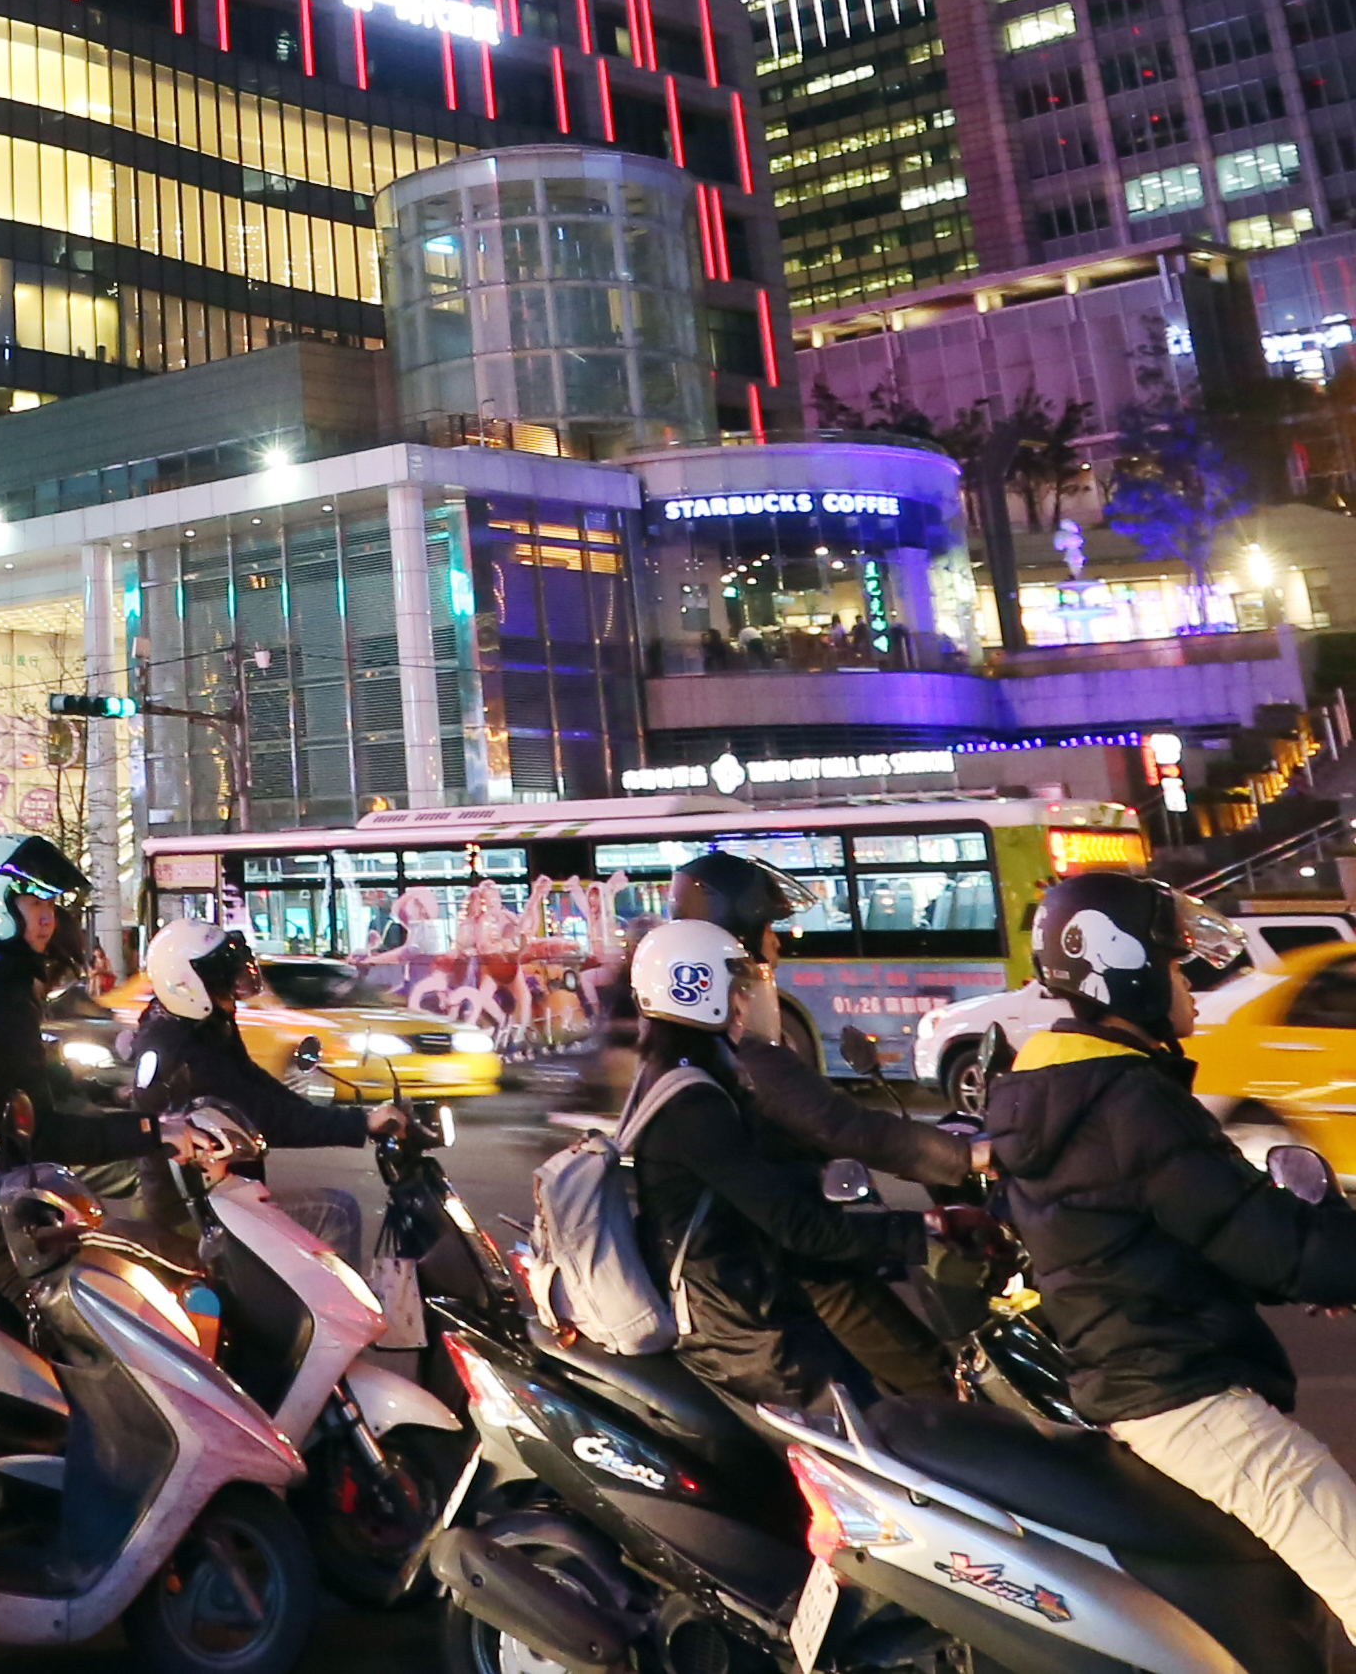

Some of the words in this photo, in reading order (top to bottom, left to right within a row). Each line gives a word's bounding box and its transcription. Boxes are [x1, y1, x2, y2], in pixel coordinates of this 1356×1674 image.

[665, 493, 813, 520] STARBUCKS
[822, 493, 900, 516] COFFEE
[791, 758, 821, 780] CITY
[860, 754, 891, 776] BUS
